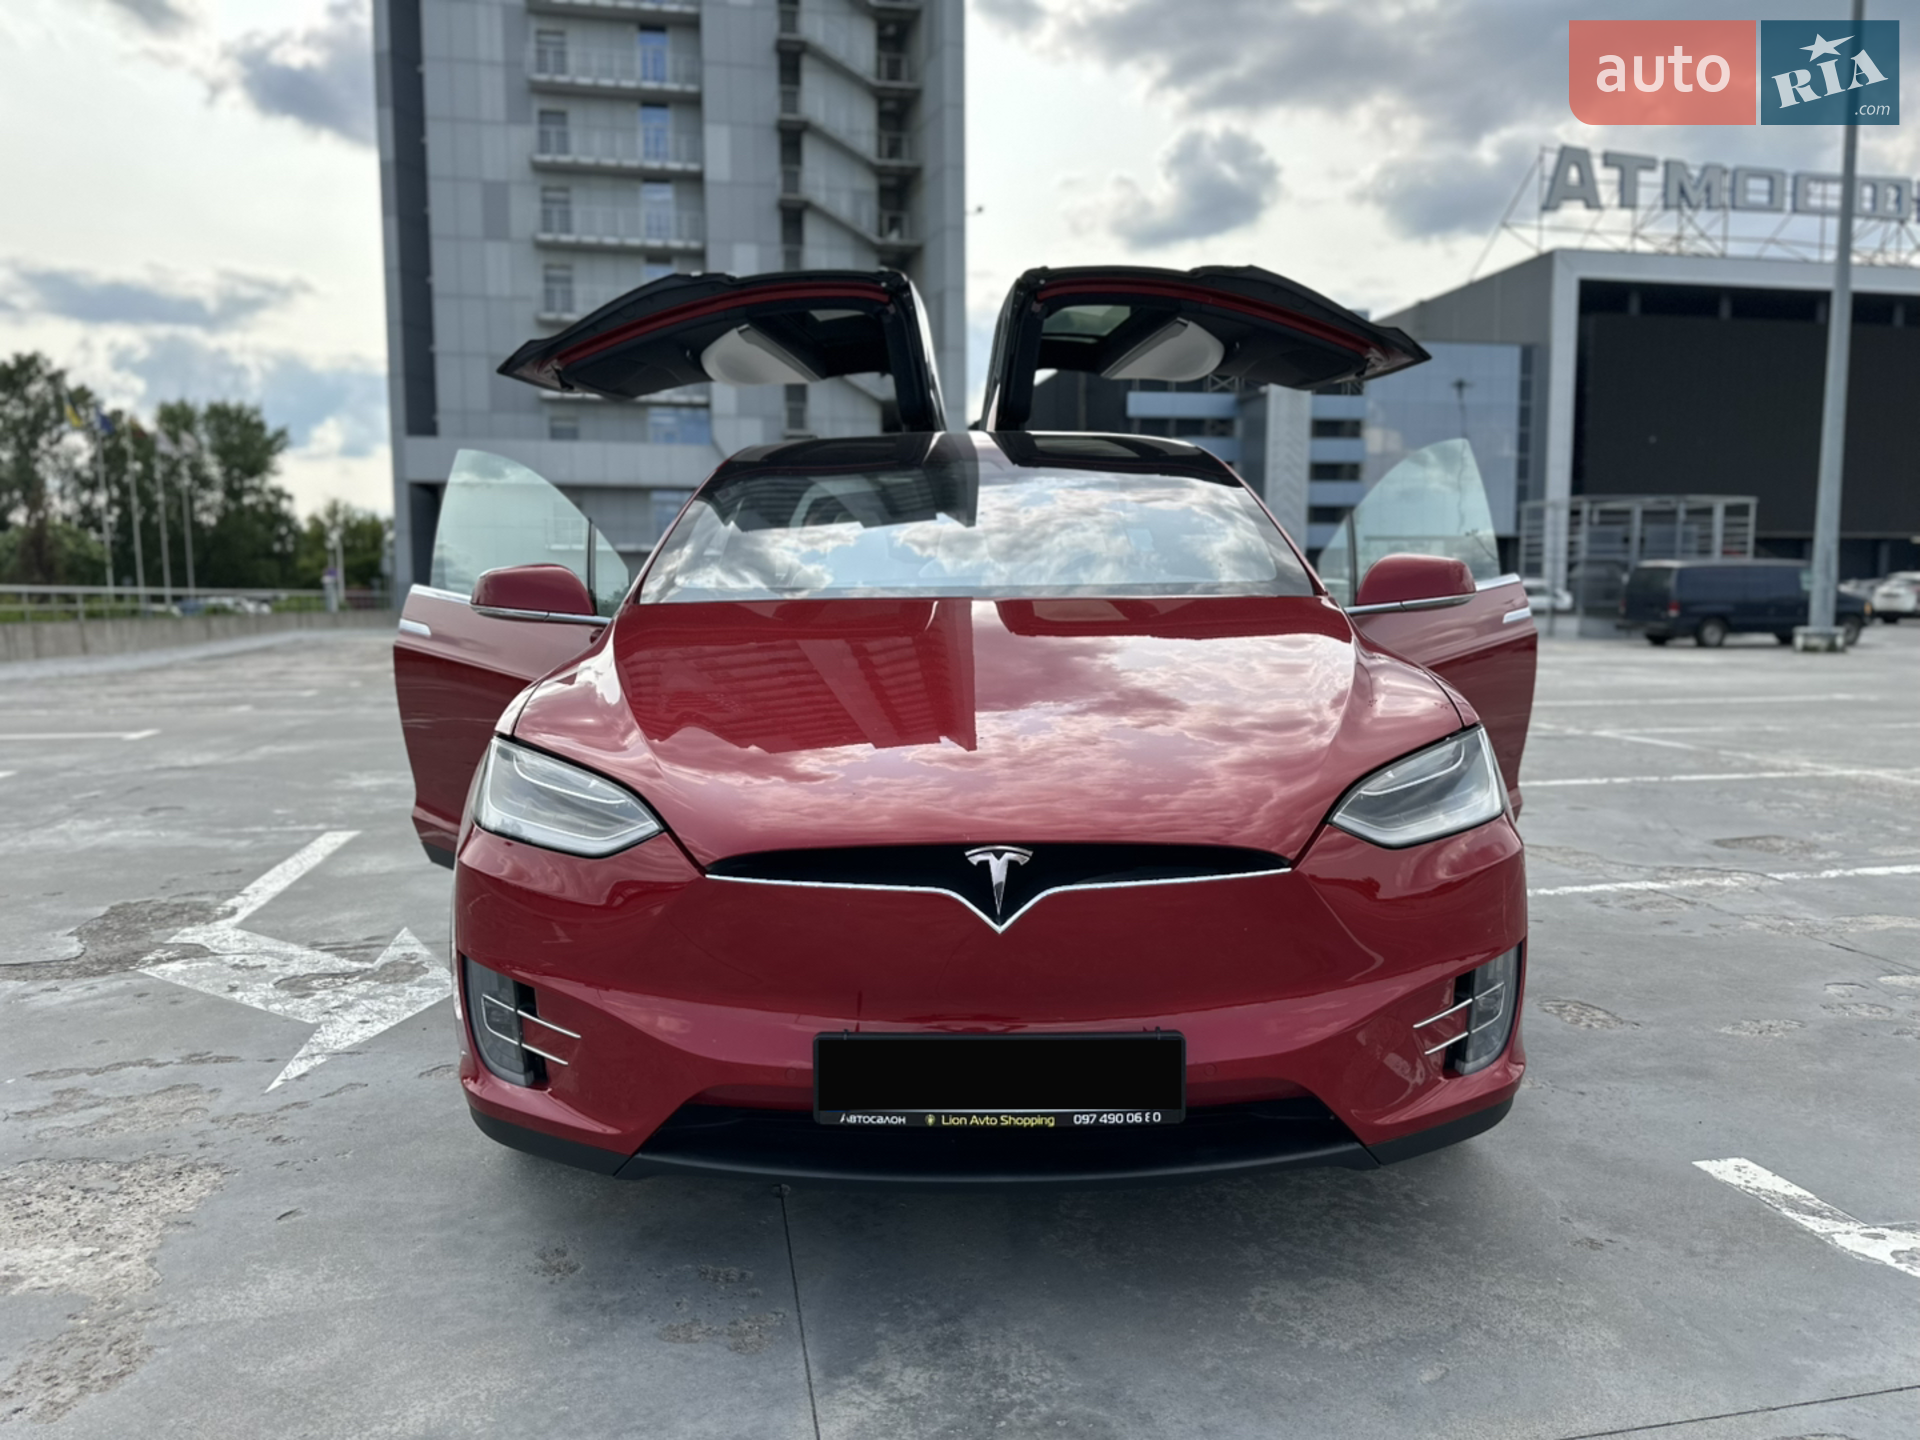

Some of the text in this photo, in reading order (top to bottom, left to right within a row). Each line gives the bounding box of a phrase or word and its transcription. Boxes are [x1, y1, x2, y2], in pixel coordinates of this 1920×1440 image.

[1541, 144, 1920, 223] АТМОСФ
[941, 1115, 1056, 1128] Lion Avto Shopping
[1073, 1114, 1097, 1125] 097
[1099, 1113, 1124, 1124] 490
[1126, 1112, 1142, 1123] 06
